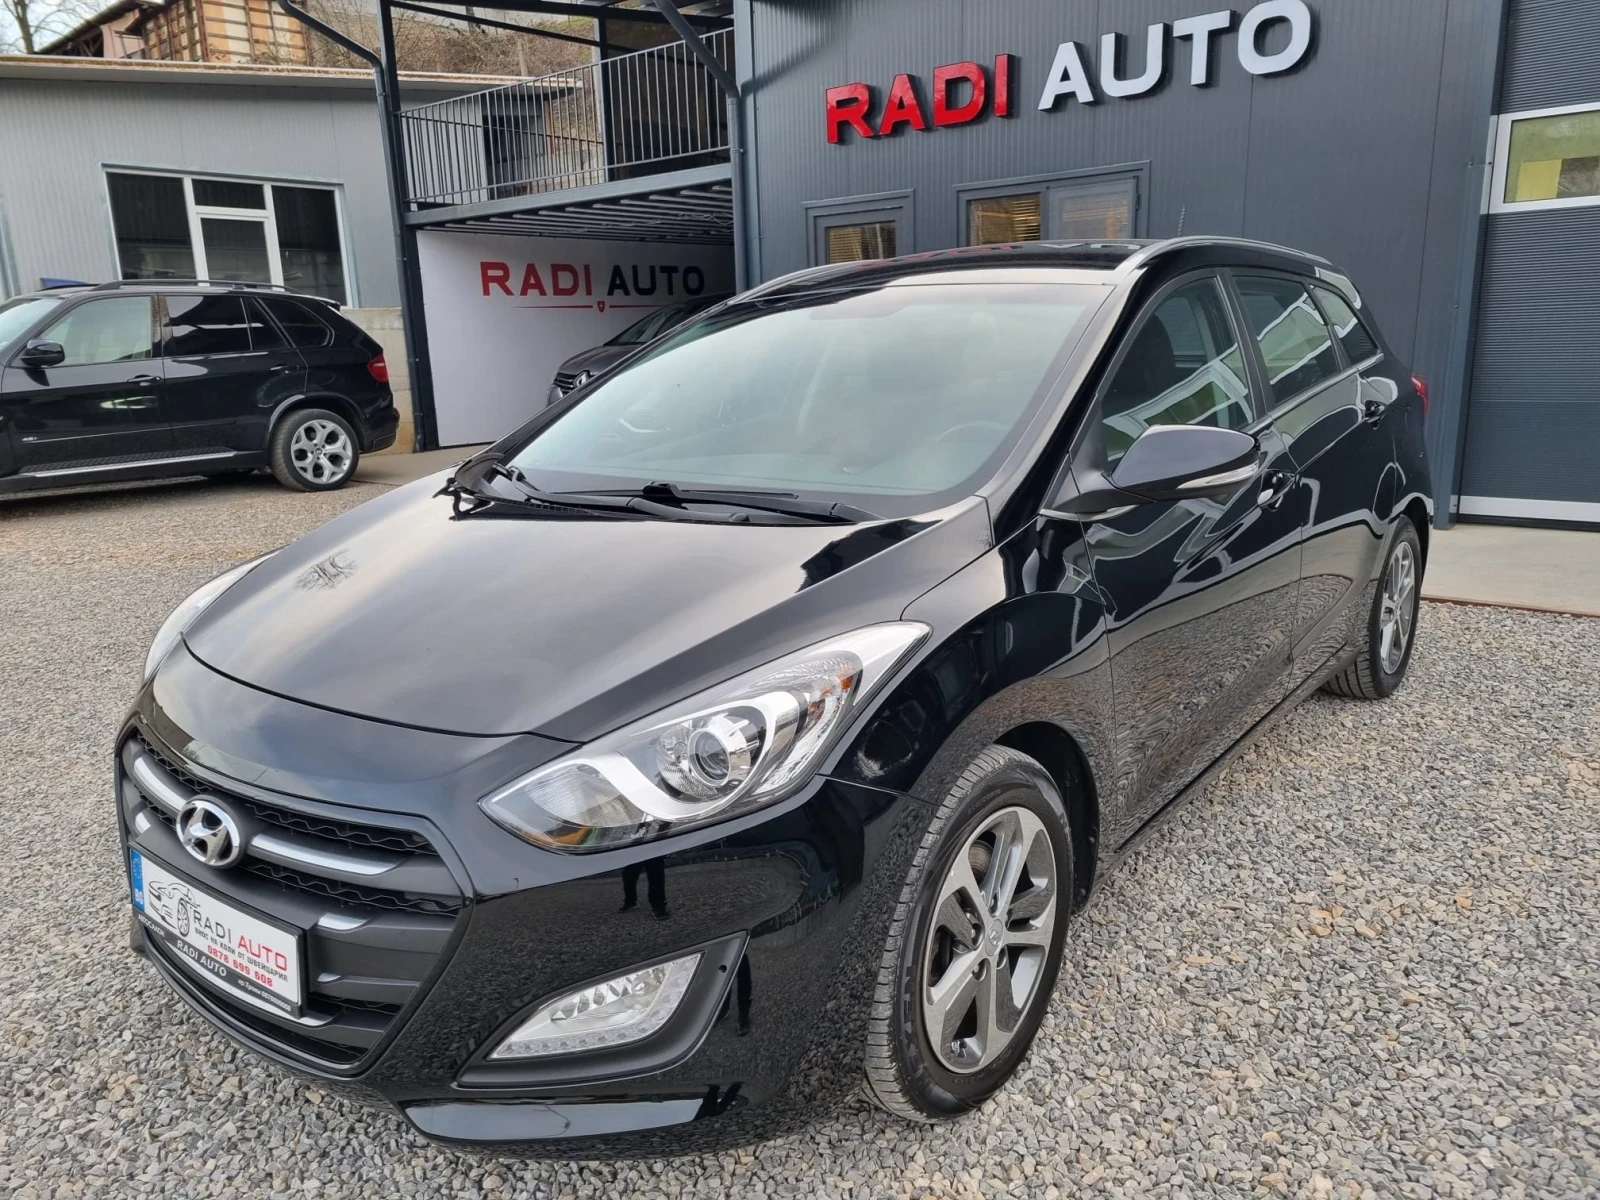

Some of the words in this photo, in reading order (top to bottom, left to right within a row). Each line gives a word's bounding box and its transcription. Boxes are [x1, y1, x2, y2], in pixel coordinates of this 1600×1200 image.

[826, 53, 1009, 144] RADI
[1038, 0, 1312, 112] AUTO
[480, 261, 593, 297] RADI
[606, 264, 706, 297] AUTO
[177, 940, 199, 960] RADI
[200, 956, 227, 977] AUTO
[193, 909, 232, 943] RADI
[238, 935, 288, 972] AUTO
[194, 926, 209, 941] ВНОС
[210, 936, 218, 946] НА
[219, 941, 236, 956] КОЛИ
[237, 951, 245, 961] ОТ
[246, 957, 288, 982] ШВЕЙЦАРИЯ
[207, 944, 230, 964] 0878
[232, 959, 251, 976] 699
[254, 970, 273, 987] 608
